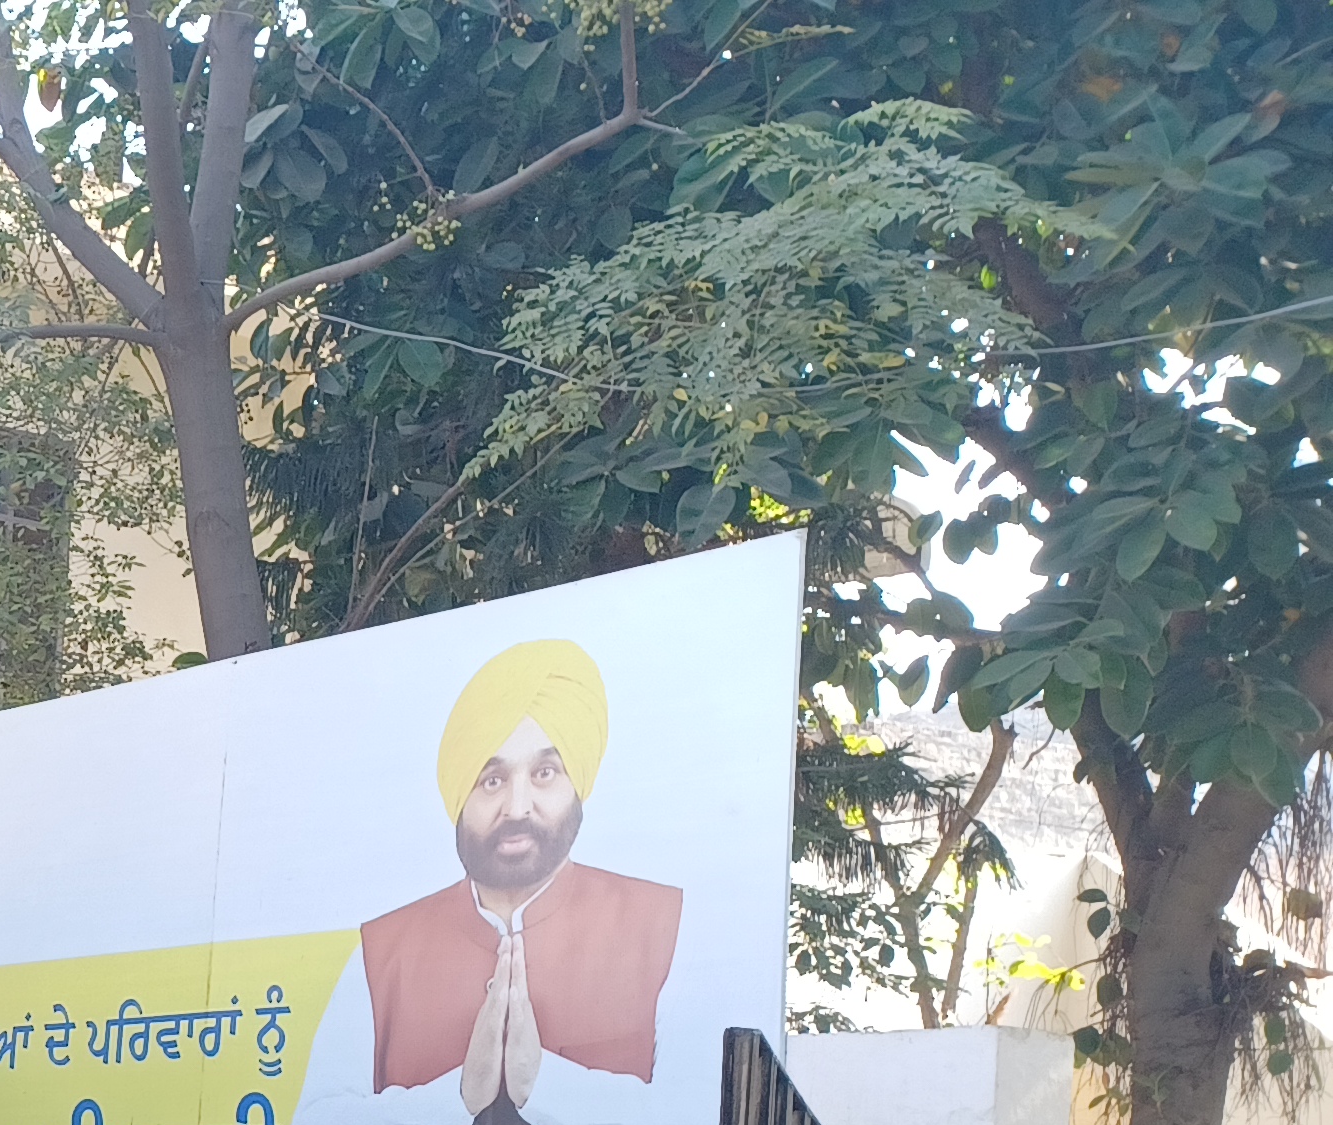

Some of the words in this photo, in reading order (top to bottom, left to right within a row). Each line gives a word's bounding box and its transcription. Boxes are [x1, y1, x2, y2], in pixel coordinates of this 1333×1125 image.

[44, 1002, 77, 1067] ਦੇ
[85, 993, 244, 1066] ਪਰਿਵਾਰਾਂ
[253, 984, 292, 1078] ਨੂੰ
